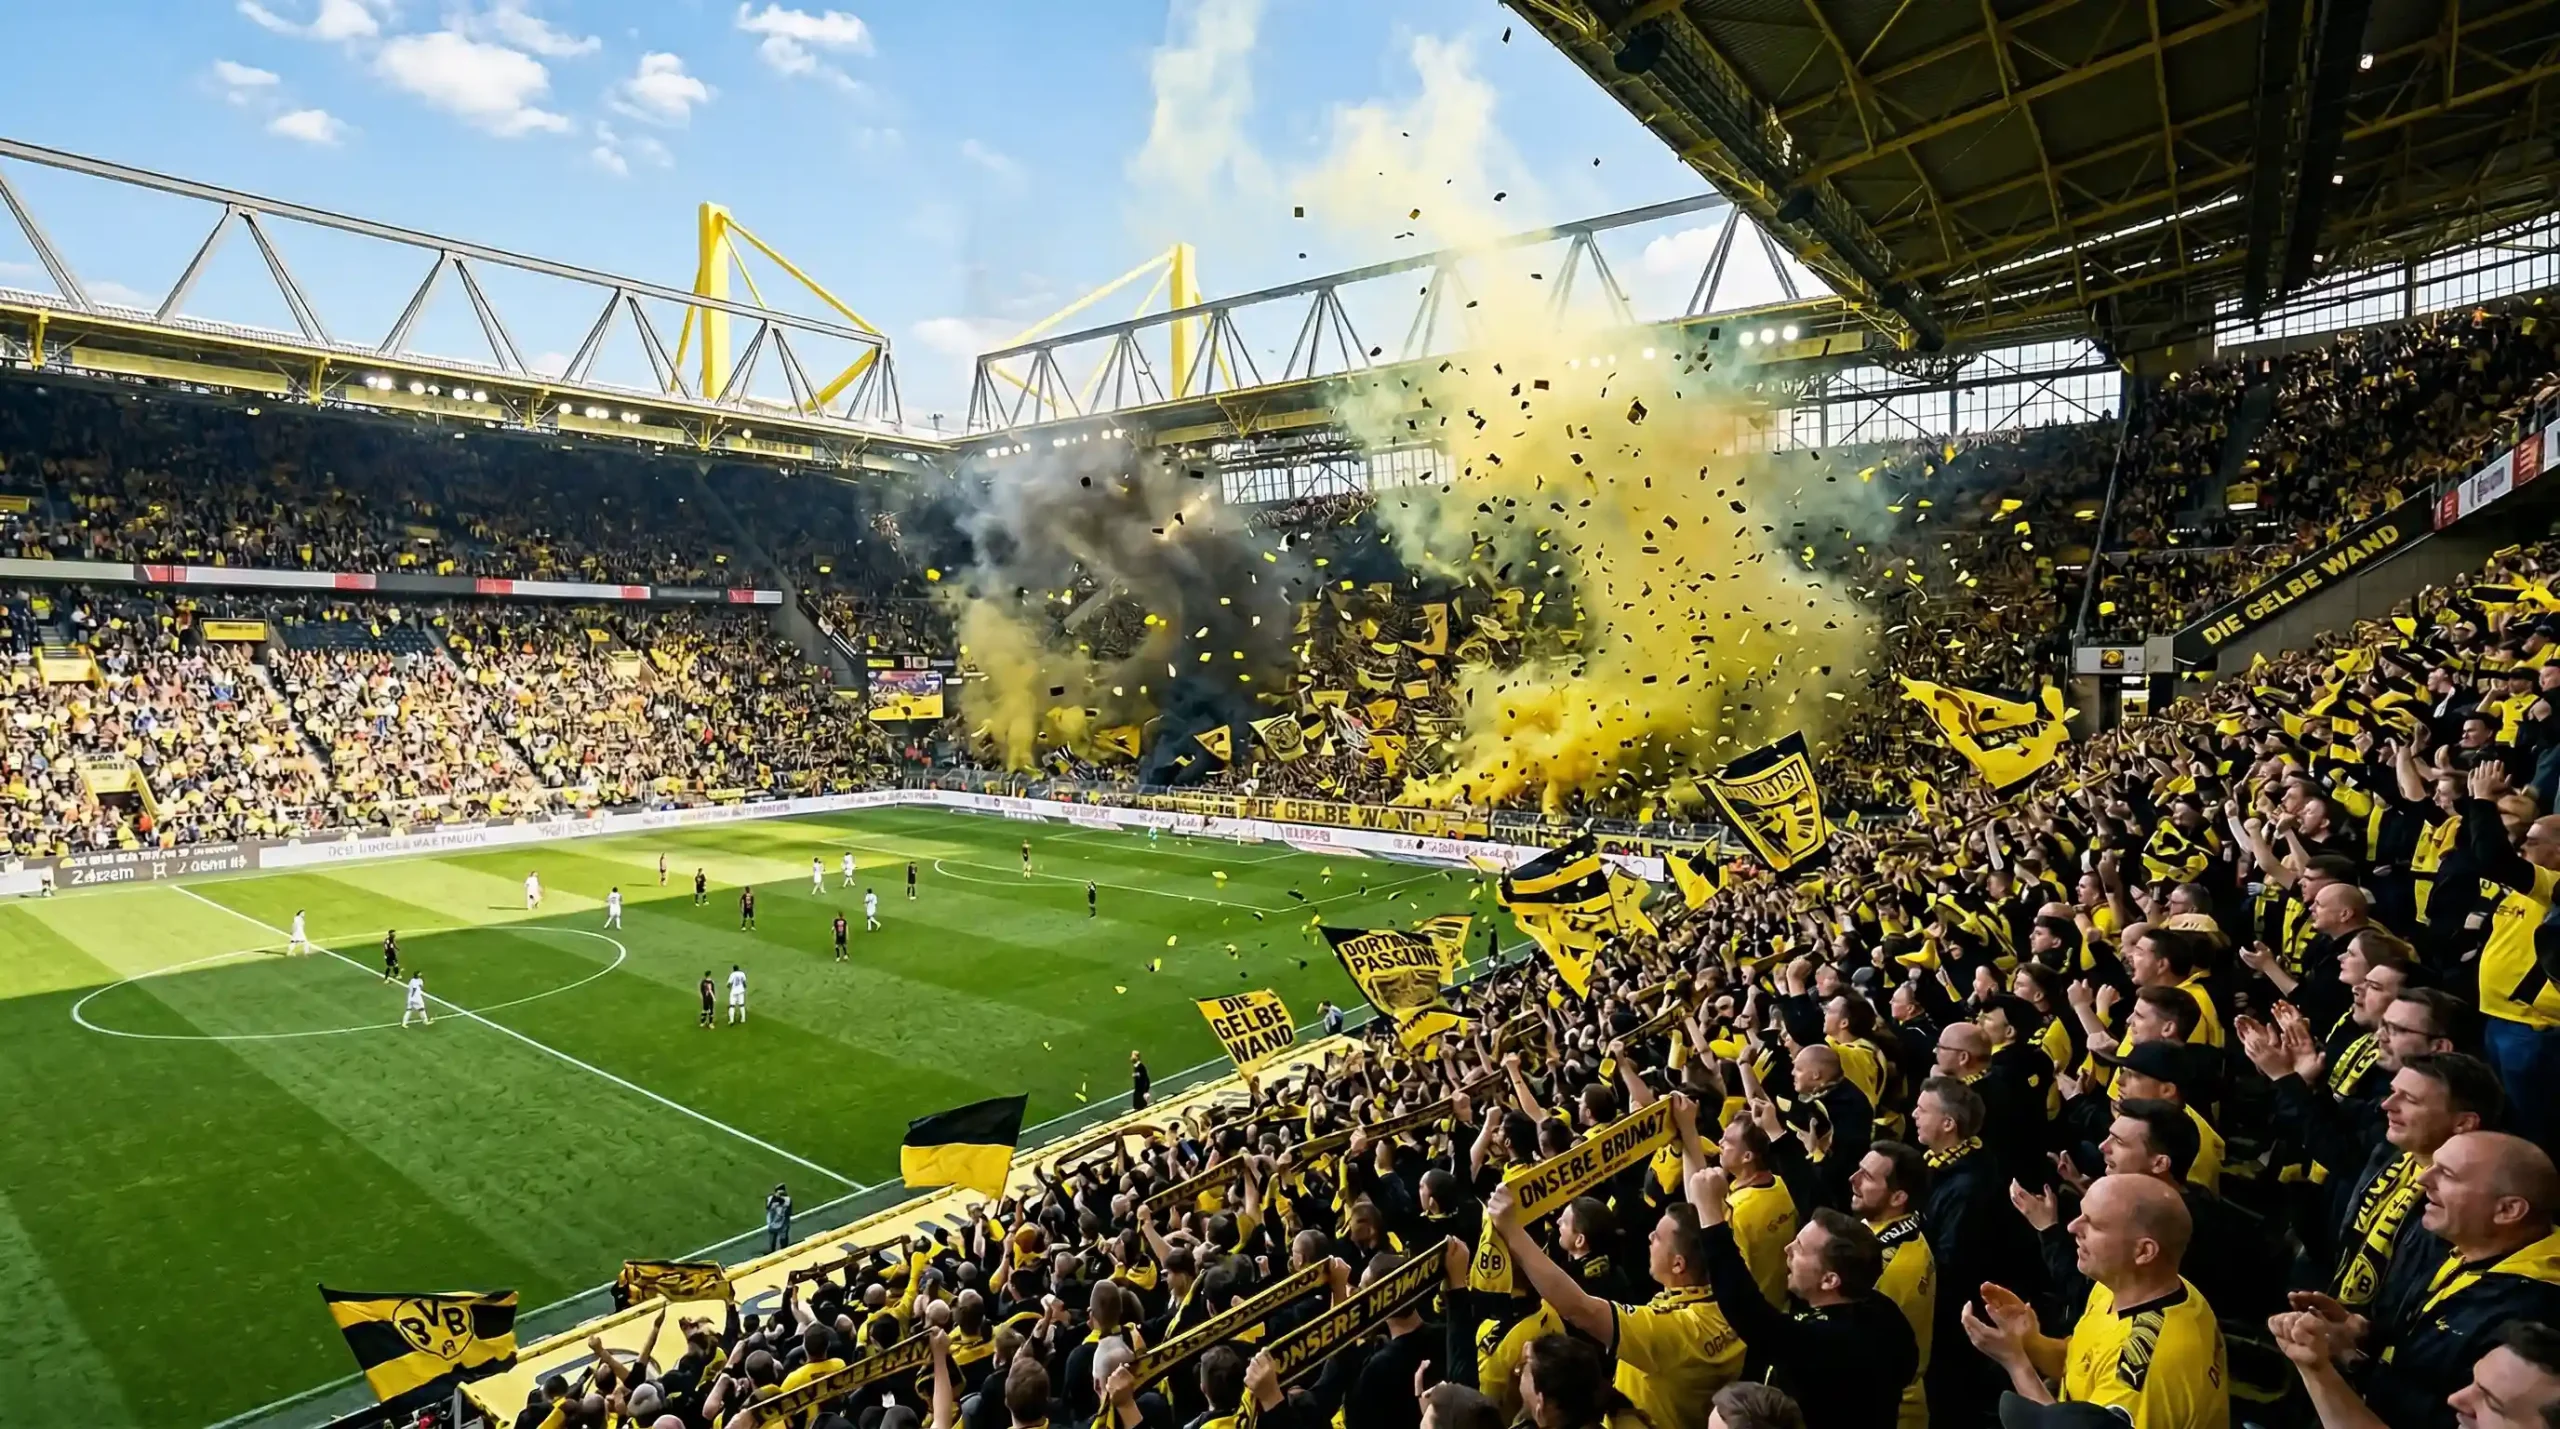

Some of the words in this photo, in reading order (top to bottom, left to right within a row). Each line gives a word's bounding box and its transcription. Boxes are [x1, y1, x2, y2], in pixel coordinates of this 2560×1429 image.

[2202, 613, 2245, 645] DIE
[2245, 569, 2323, 621] GELBE
[2320, 525, 2399, 576] WAND
[1247, 798, 1275, 818] IE
[1284, 800, 1350, 824] GELBE
[1212, 1001, 1286, 1040] GELBE
[1218, 994, 1255, 1014] DIE
[1227, 1024, 1294, 1064] WAND
[1274, 1303, 1361, 1375] UNSERE
